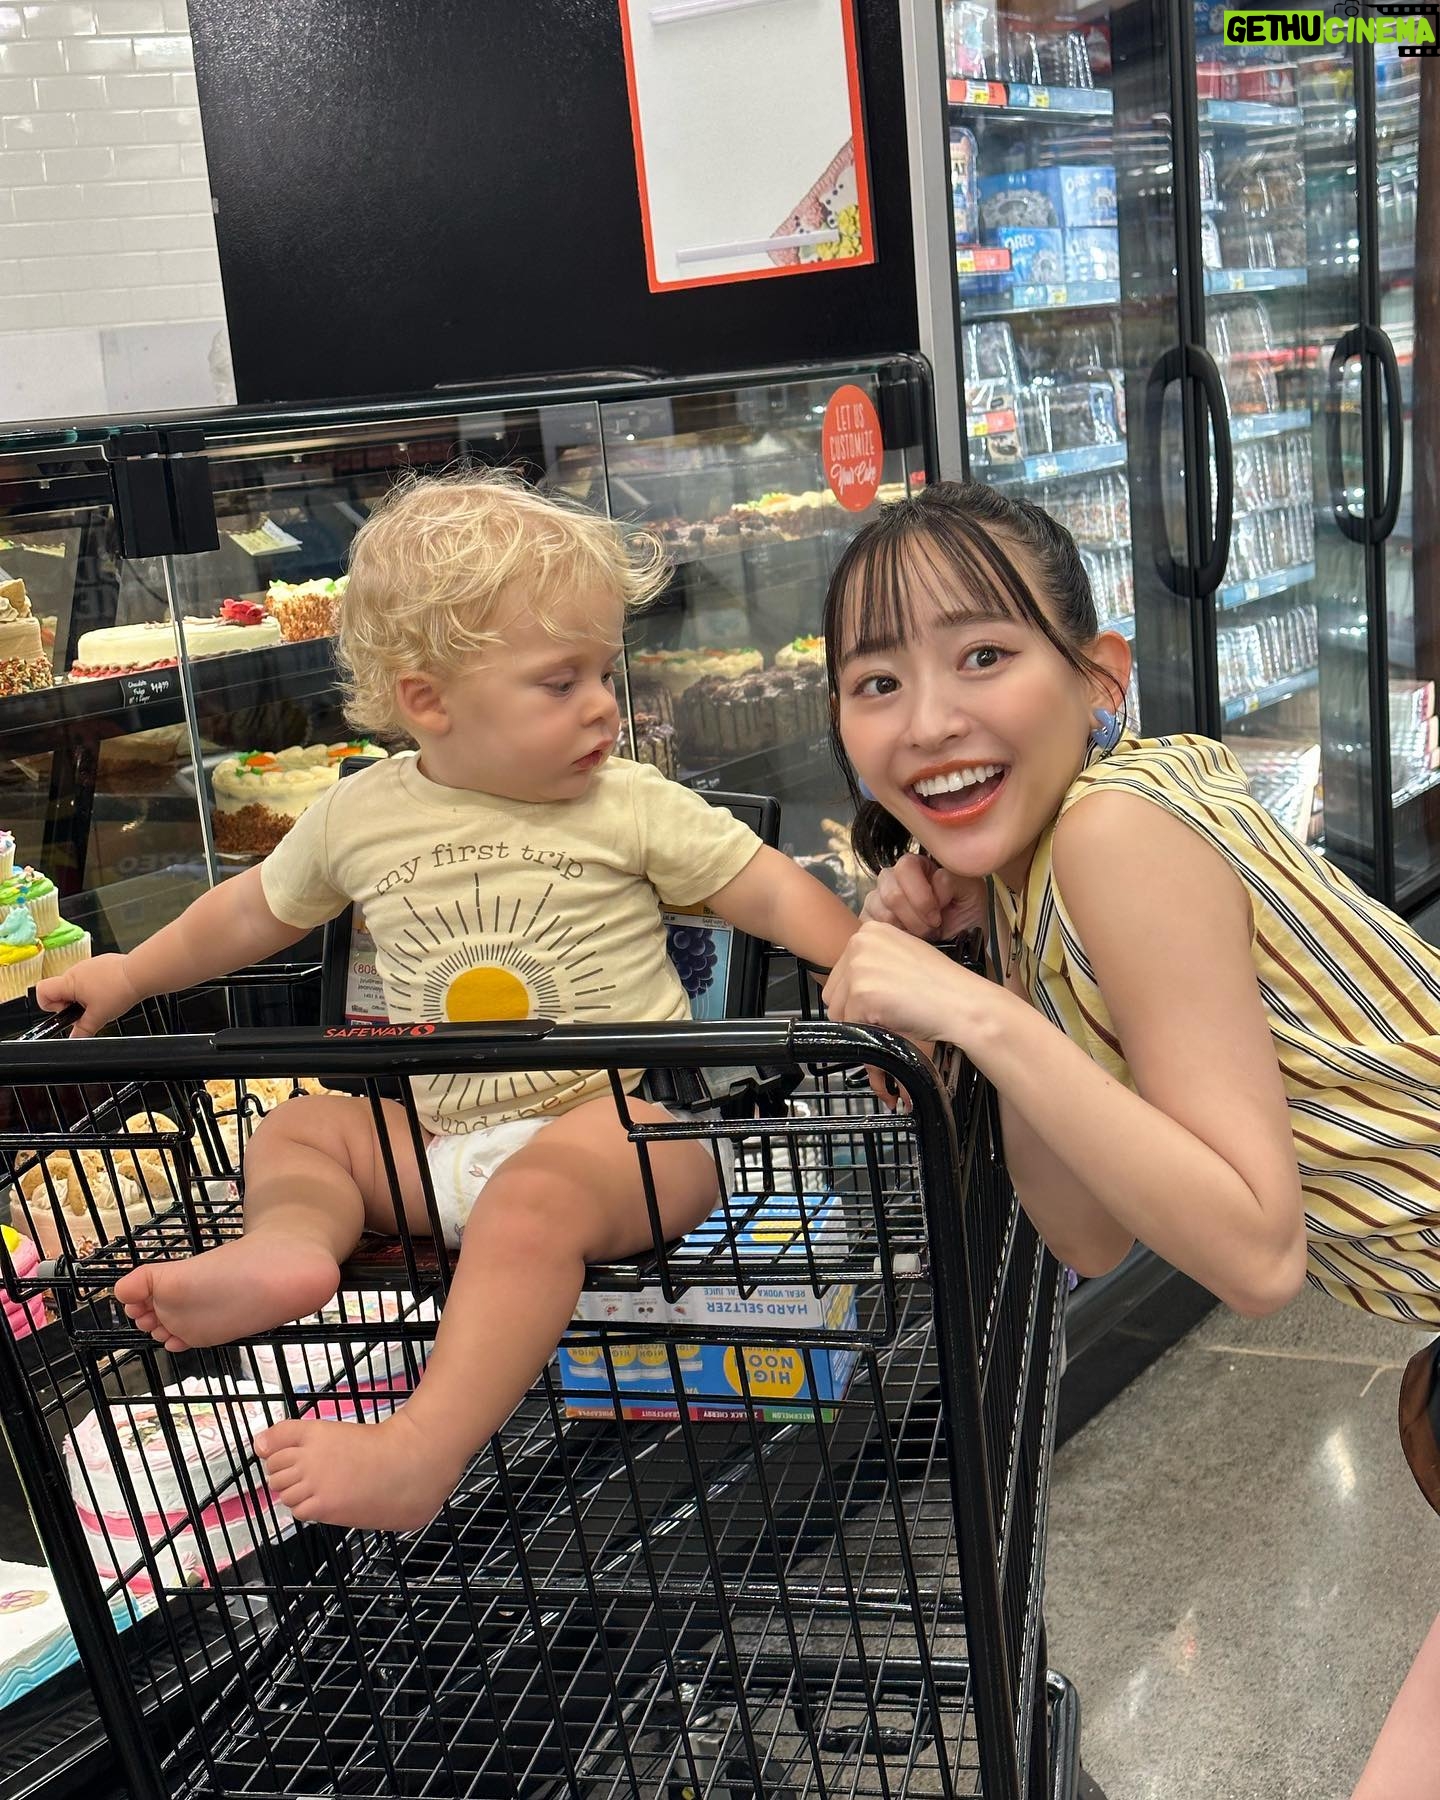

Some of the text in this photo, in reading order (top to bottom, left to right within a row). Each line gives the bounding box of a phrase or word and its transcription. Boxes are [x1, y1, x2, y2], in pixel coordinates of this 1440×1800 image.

[835, 402, 865, 432] LET US
[828, 429, 875, 462] CUSTOMIZE
[374, 841, 584, 896] my first trip
[323, 1026, 411, 1039] SAFEWAY
[703, 1287, 724, 1297] JUICE
[757, 1288, 784, 1298] VODKA
[785, 1289, 806, 1298] REAL
[706, 1301, 808, 1316] HARD SELTZER
[735, 1354, 794, 1370] NOO
[746, 1369, 791, 1385] HIG
[704, 1410, 729, 1419] CHERRY
